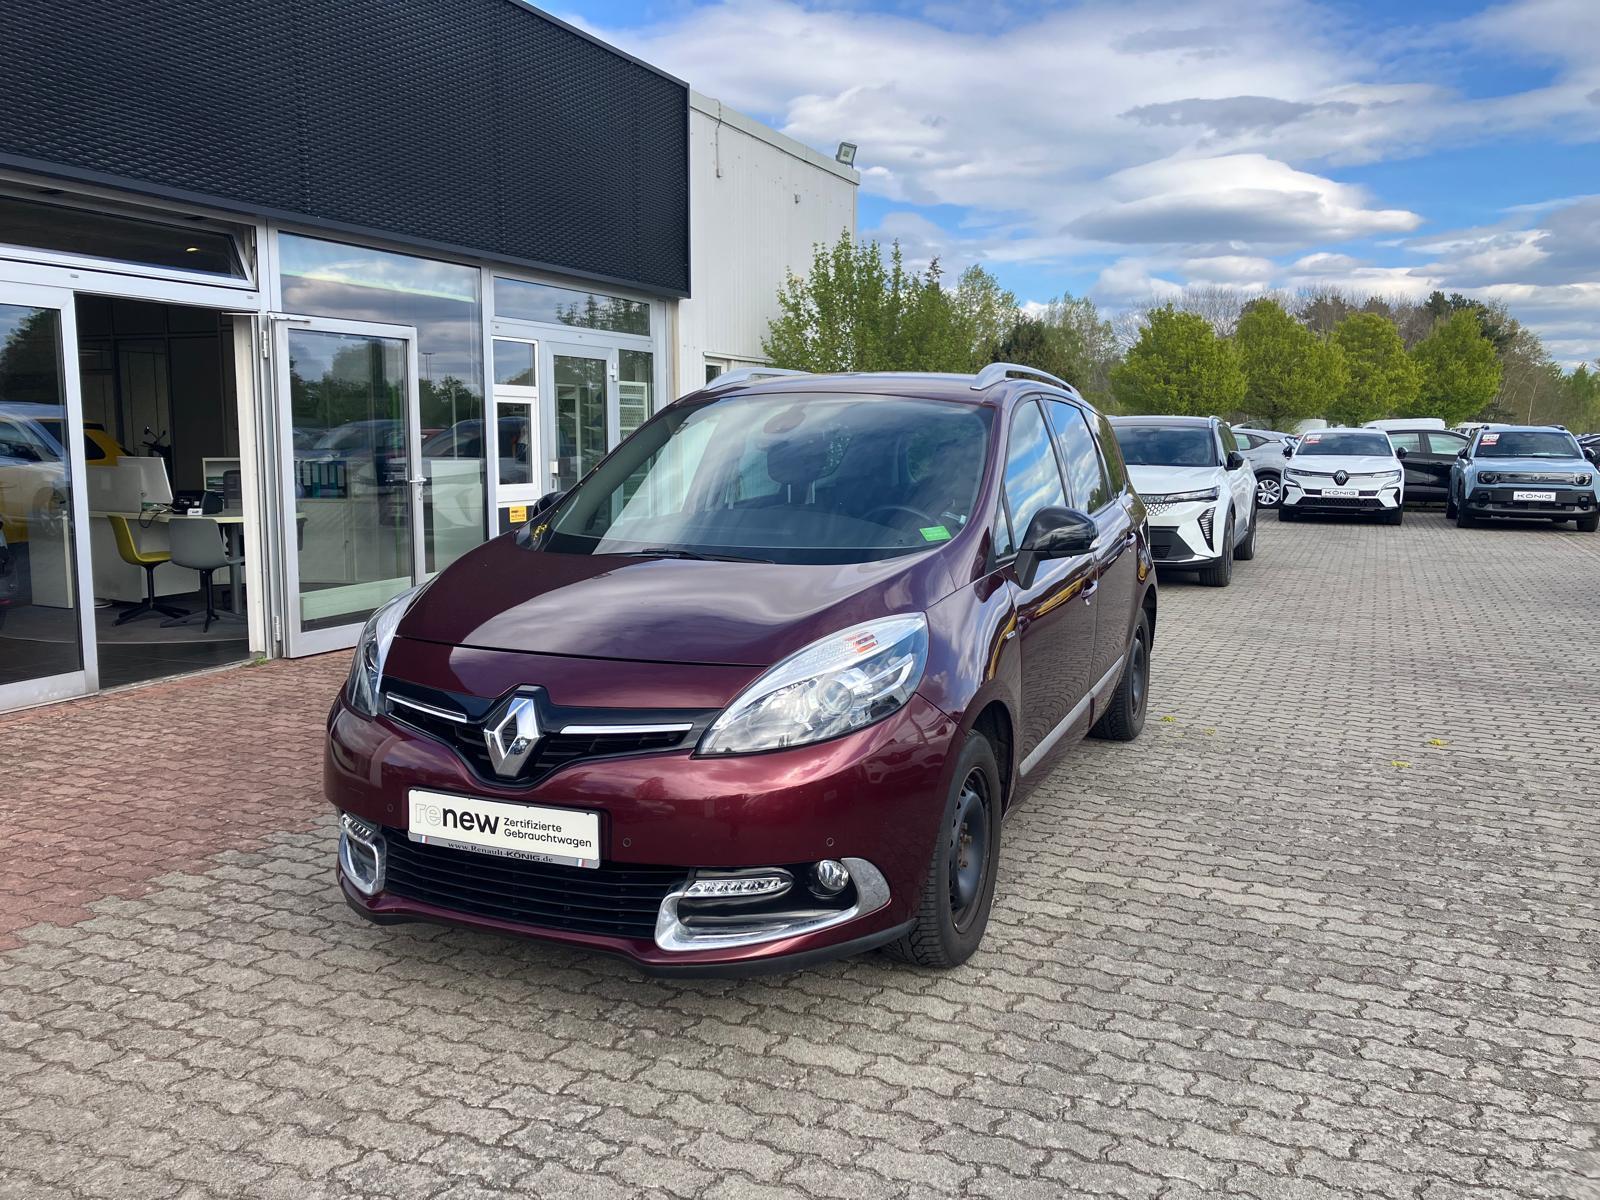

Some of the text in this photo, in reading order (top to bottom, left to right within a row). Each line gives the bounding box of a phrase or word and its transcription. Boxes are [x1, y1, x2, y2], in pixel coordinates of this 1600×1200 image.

[503, 817, 562, 833] Zertifizierte
[504, 828, 592, 848] Gebrauchtwagen
[447, 841, 553, 863] www.Renault-KÖNIG.de
